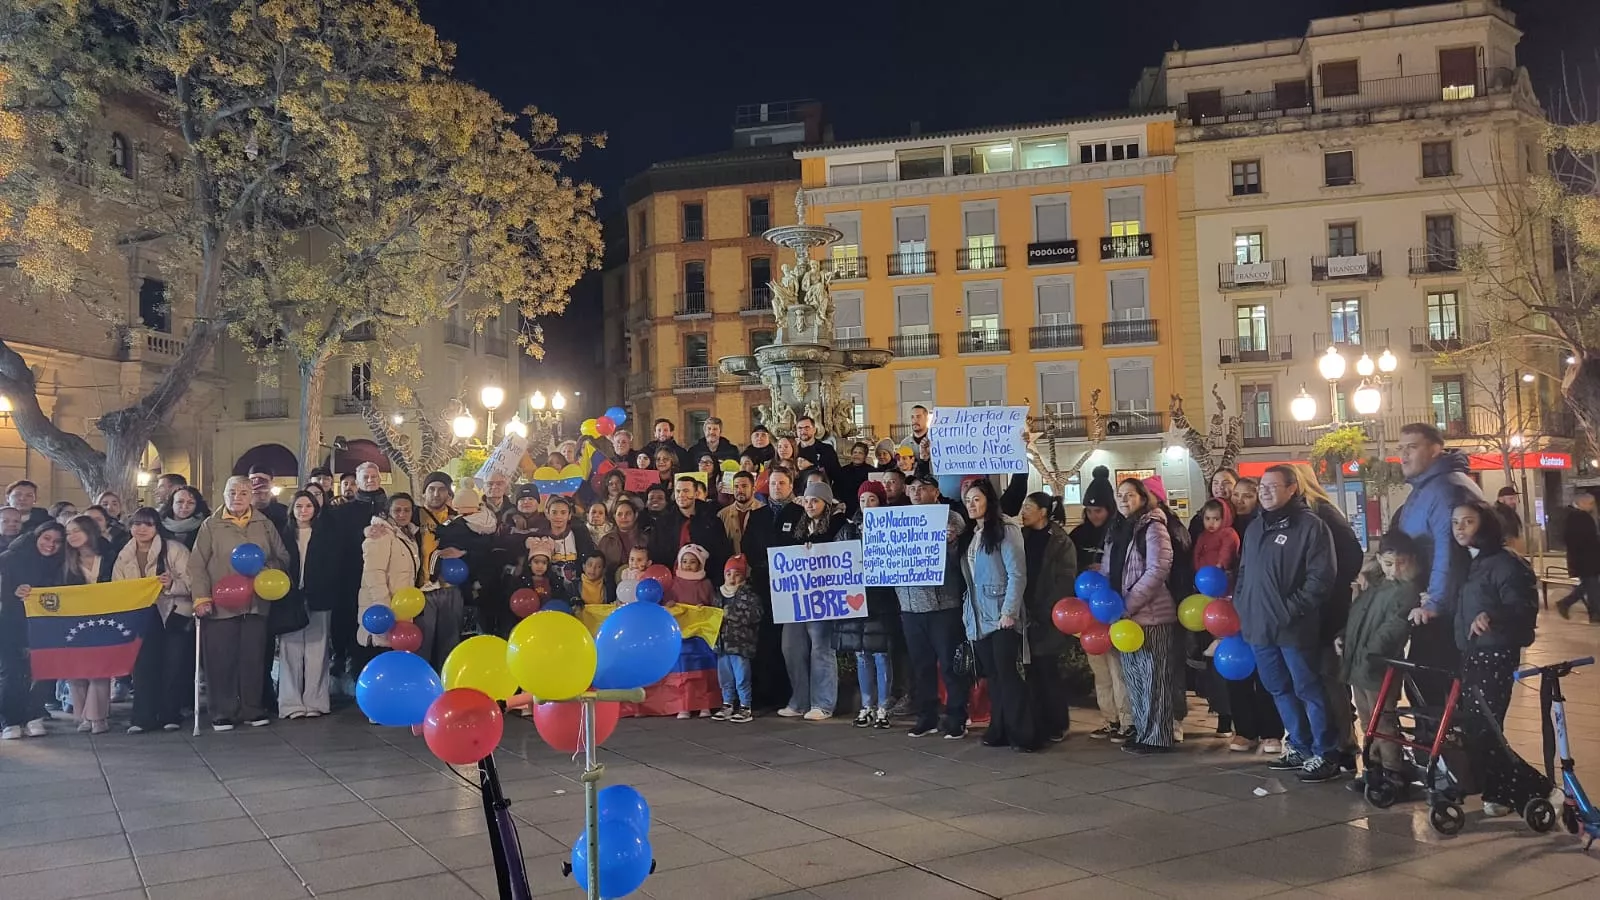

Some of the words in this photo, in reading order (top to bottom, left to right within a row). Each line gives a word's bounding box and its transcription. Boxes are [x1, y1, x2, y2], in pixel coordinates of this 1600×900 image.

[955, 409, 1004, 424] libertad
[930, 423, 977, 441] permite
[982, 422, 1014, 443] dejar
[931, 440, 942, 458] el
[945, 440, 978, 455] miedo
[979, 457, 988, 469] el
[773, 551, 852, 574] Queremos
[772, 575, 799, 592] UNA
[800, 568, 862, 591] Venezuela
[792, 589, 849, 622] LIBRE
